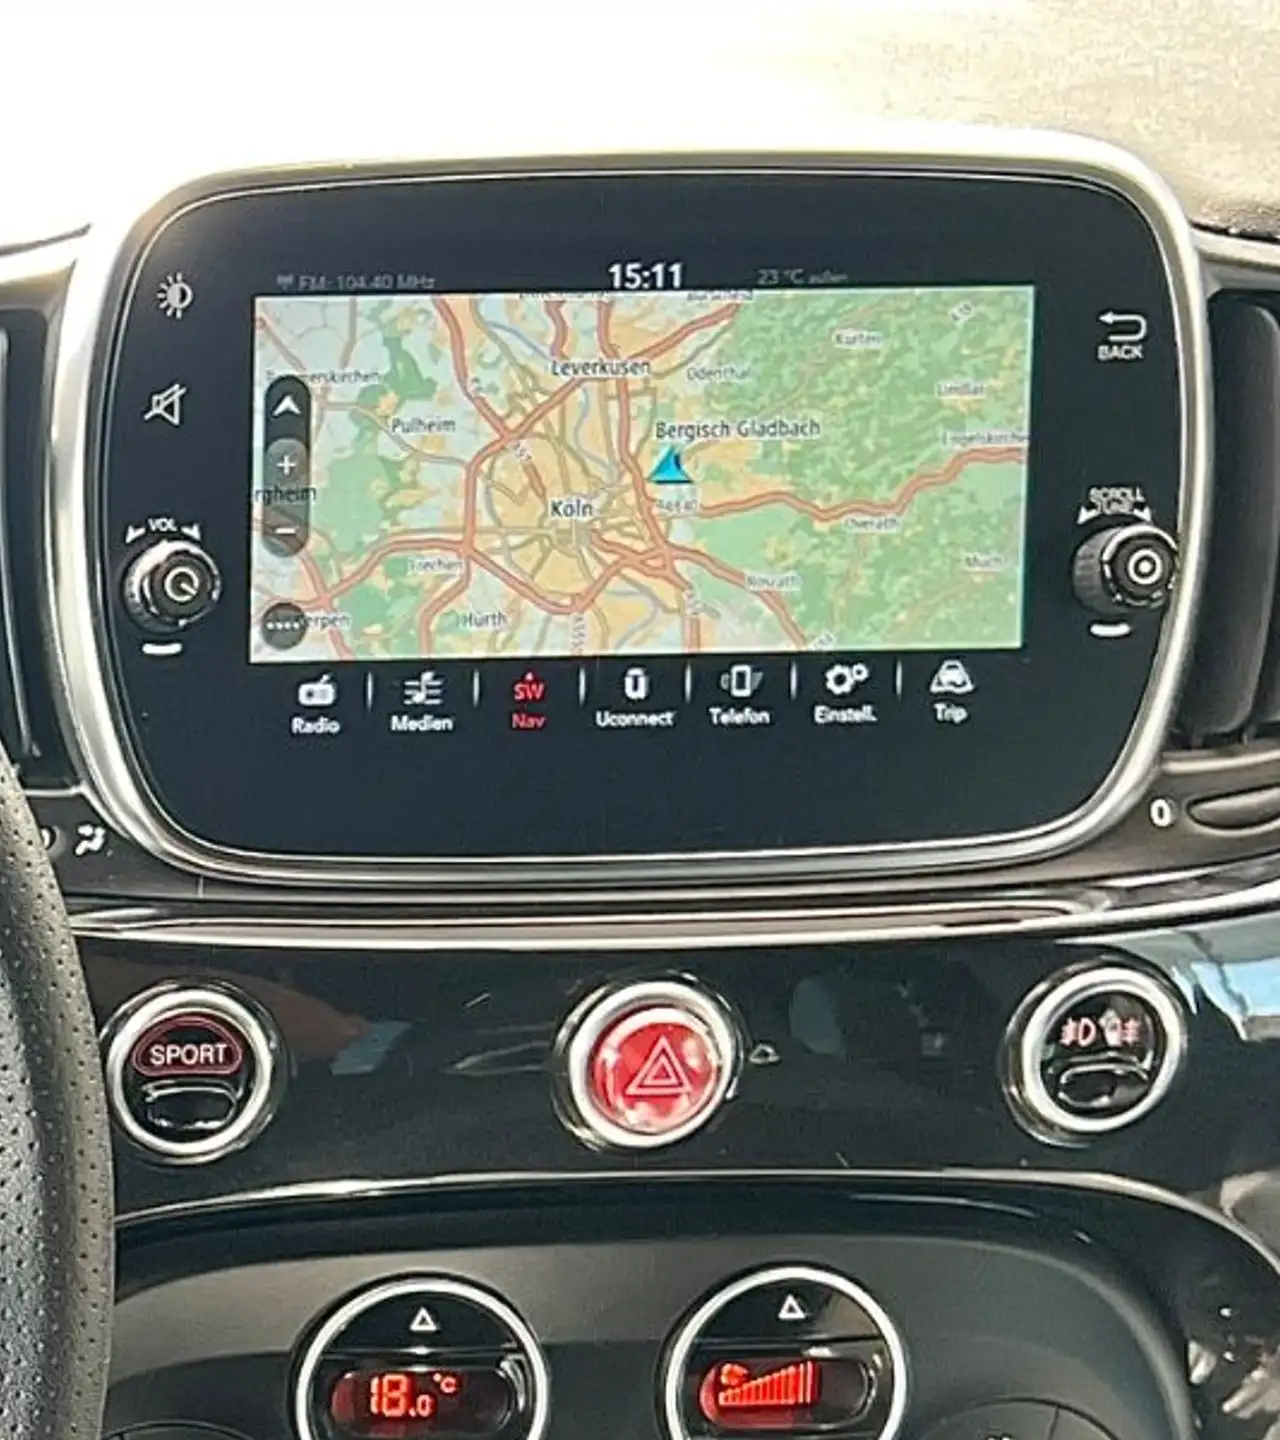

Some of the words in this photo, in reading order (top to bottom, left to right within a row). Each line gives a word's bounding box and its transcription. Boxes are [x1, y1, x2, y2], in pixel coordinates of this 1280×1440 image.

[608, 263, 683, 289] 15:11
[757, 269, 780, 284] 23
[1097, 346, 1144, 360] BACK
[551, 359, 651, 376] Leverkusen
[656, 419, 731, 440] Bergisch
[736, 418, 821, 437] Gladbach
[148, 518, 178, 532] VOL
[511, 713, 546, 729] Nav
[595, 711, 675, 728] Uconnect
[709, 708, 771, 725] Telefon
[814, 706, 878, 724] Einstell.
[934, 704, 968, 724] Trip
[291, 717, 340, 735] Radio
[391, 715, 454, 732] Medien
[149, 1041, 228, 1070] SPORT
[369, 1373, 433, 1418] 18.0
